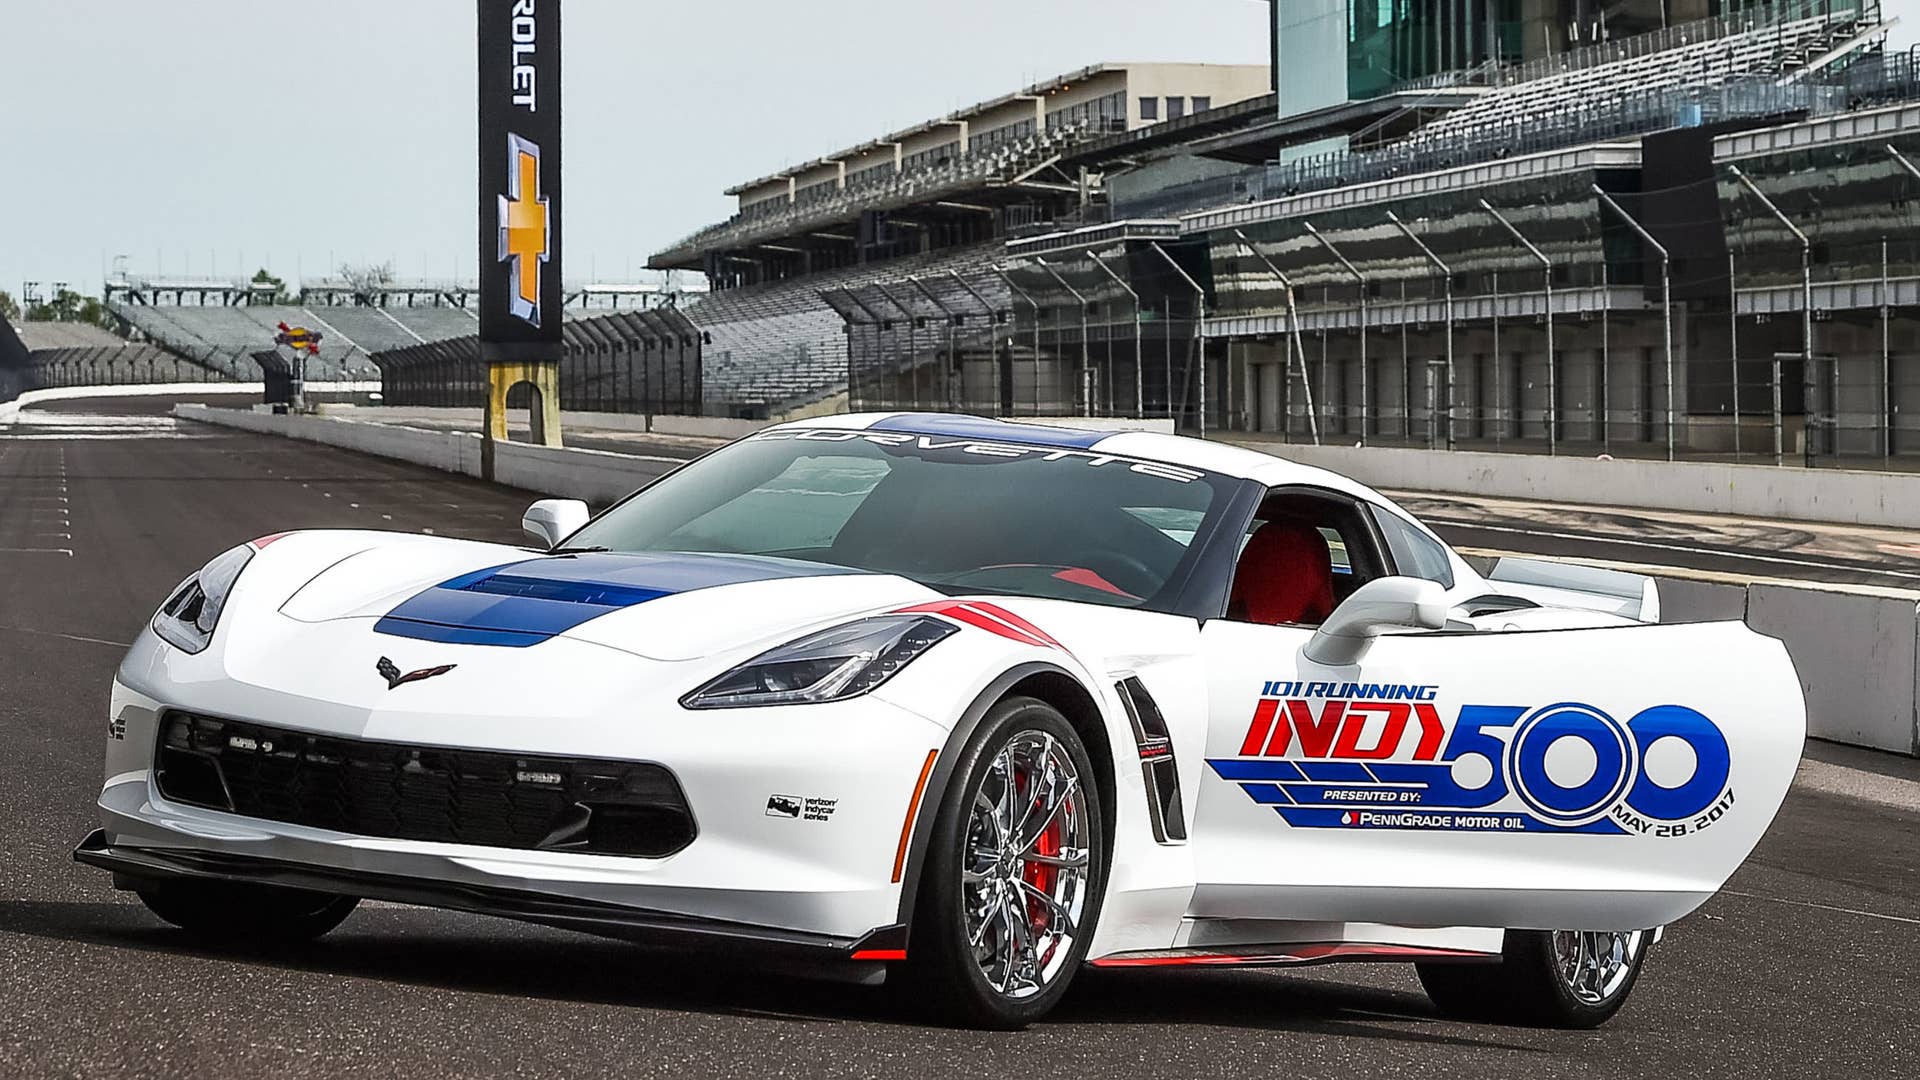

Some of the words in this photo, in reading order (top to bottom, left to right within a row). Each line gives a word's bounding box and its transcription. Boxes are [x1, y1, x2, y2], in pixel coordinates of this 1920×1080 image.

[753, 428, 1206, 483] CORVETTE
[1261, 681, 1303, 697] 101
[1304, 682, 1439, 701] RUNNING
[1238, 699, 1446, 761] INDY
[1440, 702, 1731, 827] 500
[1323, 790, 1397, 802] PRESENTED
[1399, 792, 1421, 803] BY:
[1454, 815, 1500, 829] MOTOR
[1503, 817, 1525, 829] OIL
[1611, 803, 1653, 834] MAY
